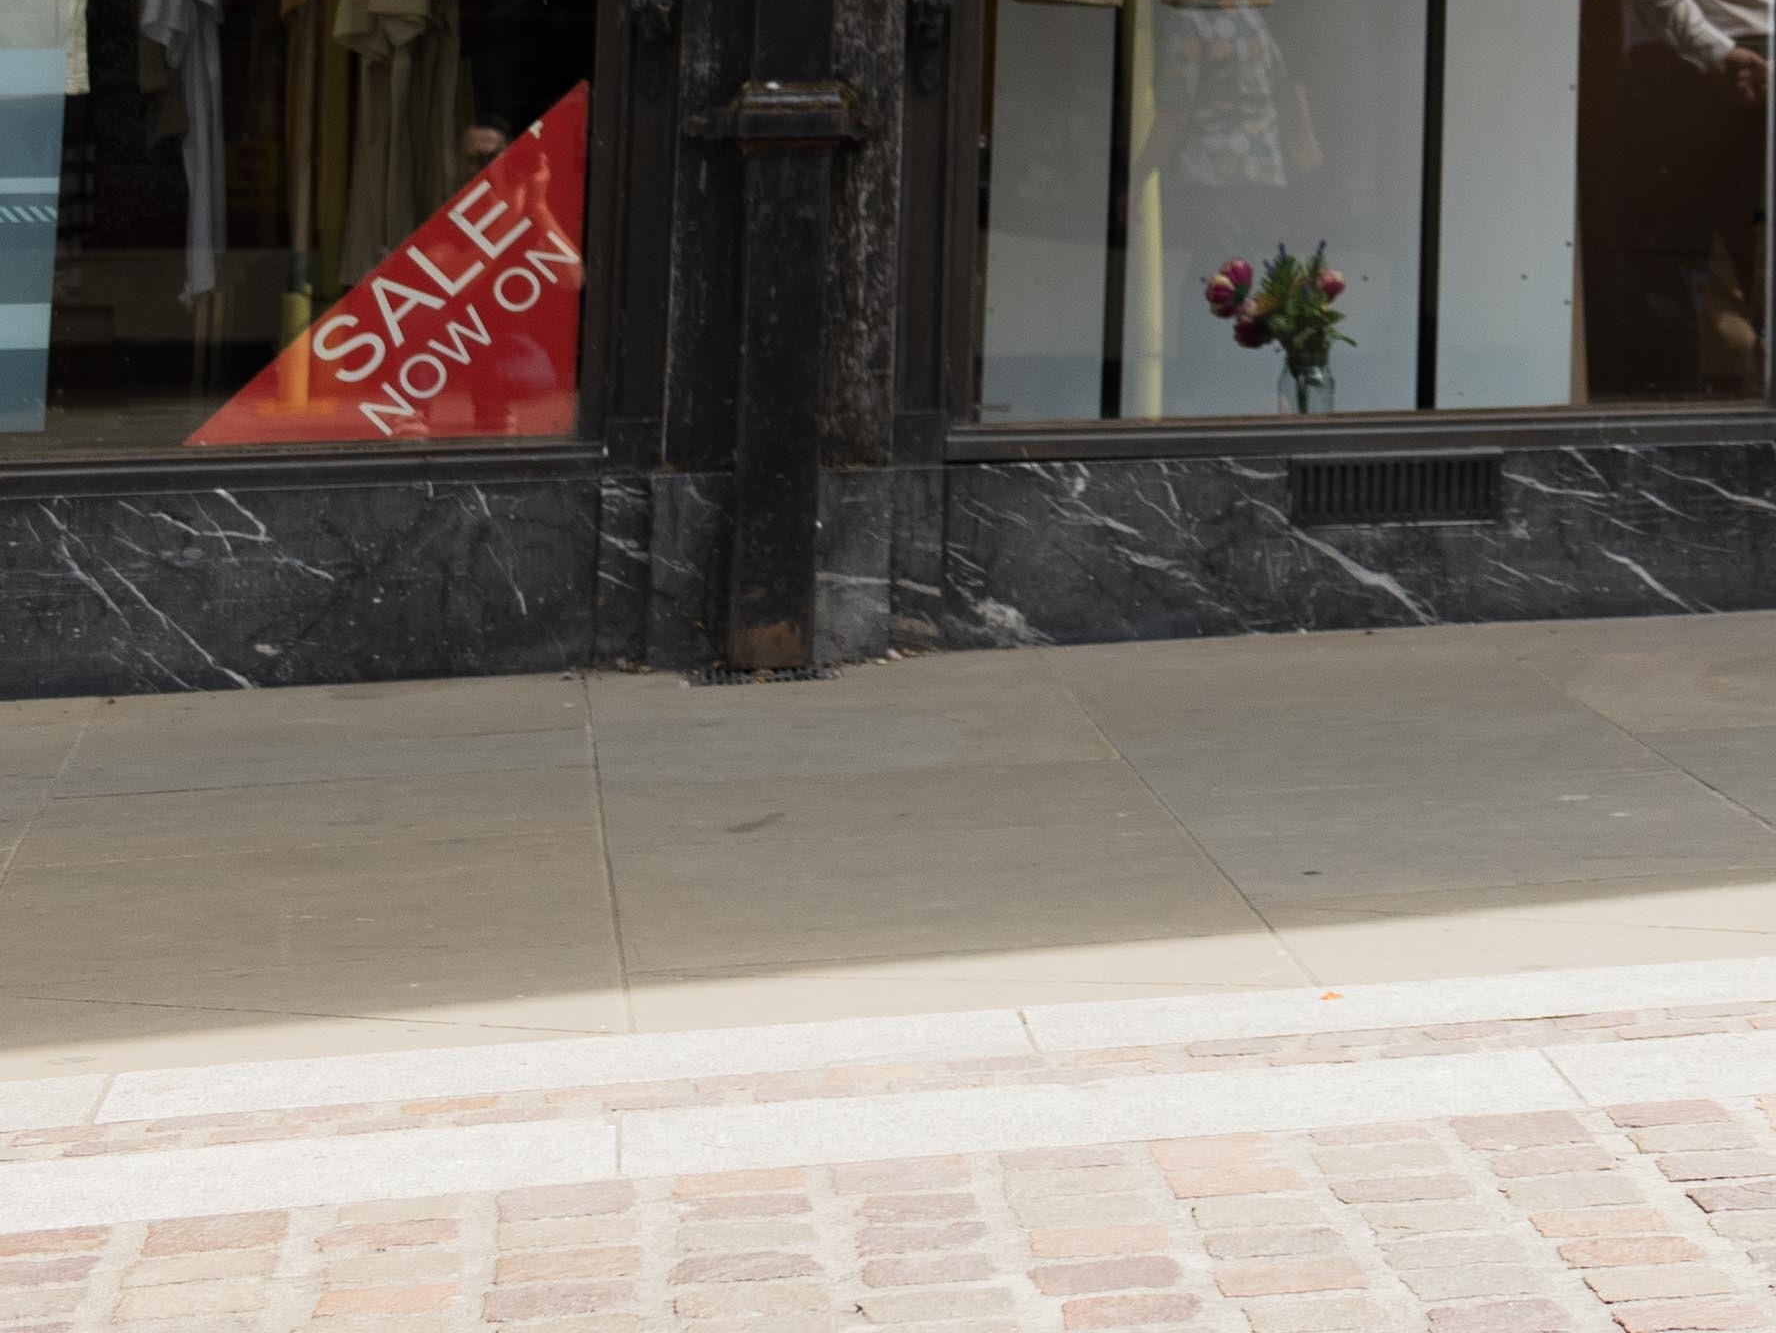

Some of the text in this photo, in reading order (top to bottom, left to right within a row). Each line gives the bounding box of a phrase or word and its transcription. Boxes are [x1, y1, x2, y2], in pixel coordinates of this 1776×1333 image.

[311, 180, 532, 383] SALE
[358, 230, 581, 436] NOW ON
